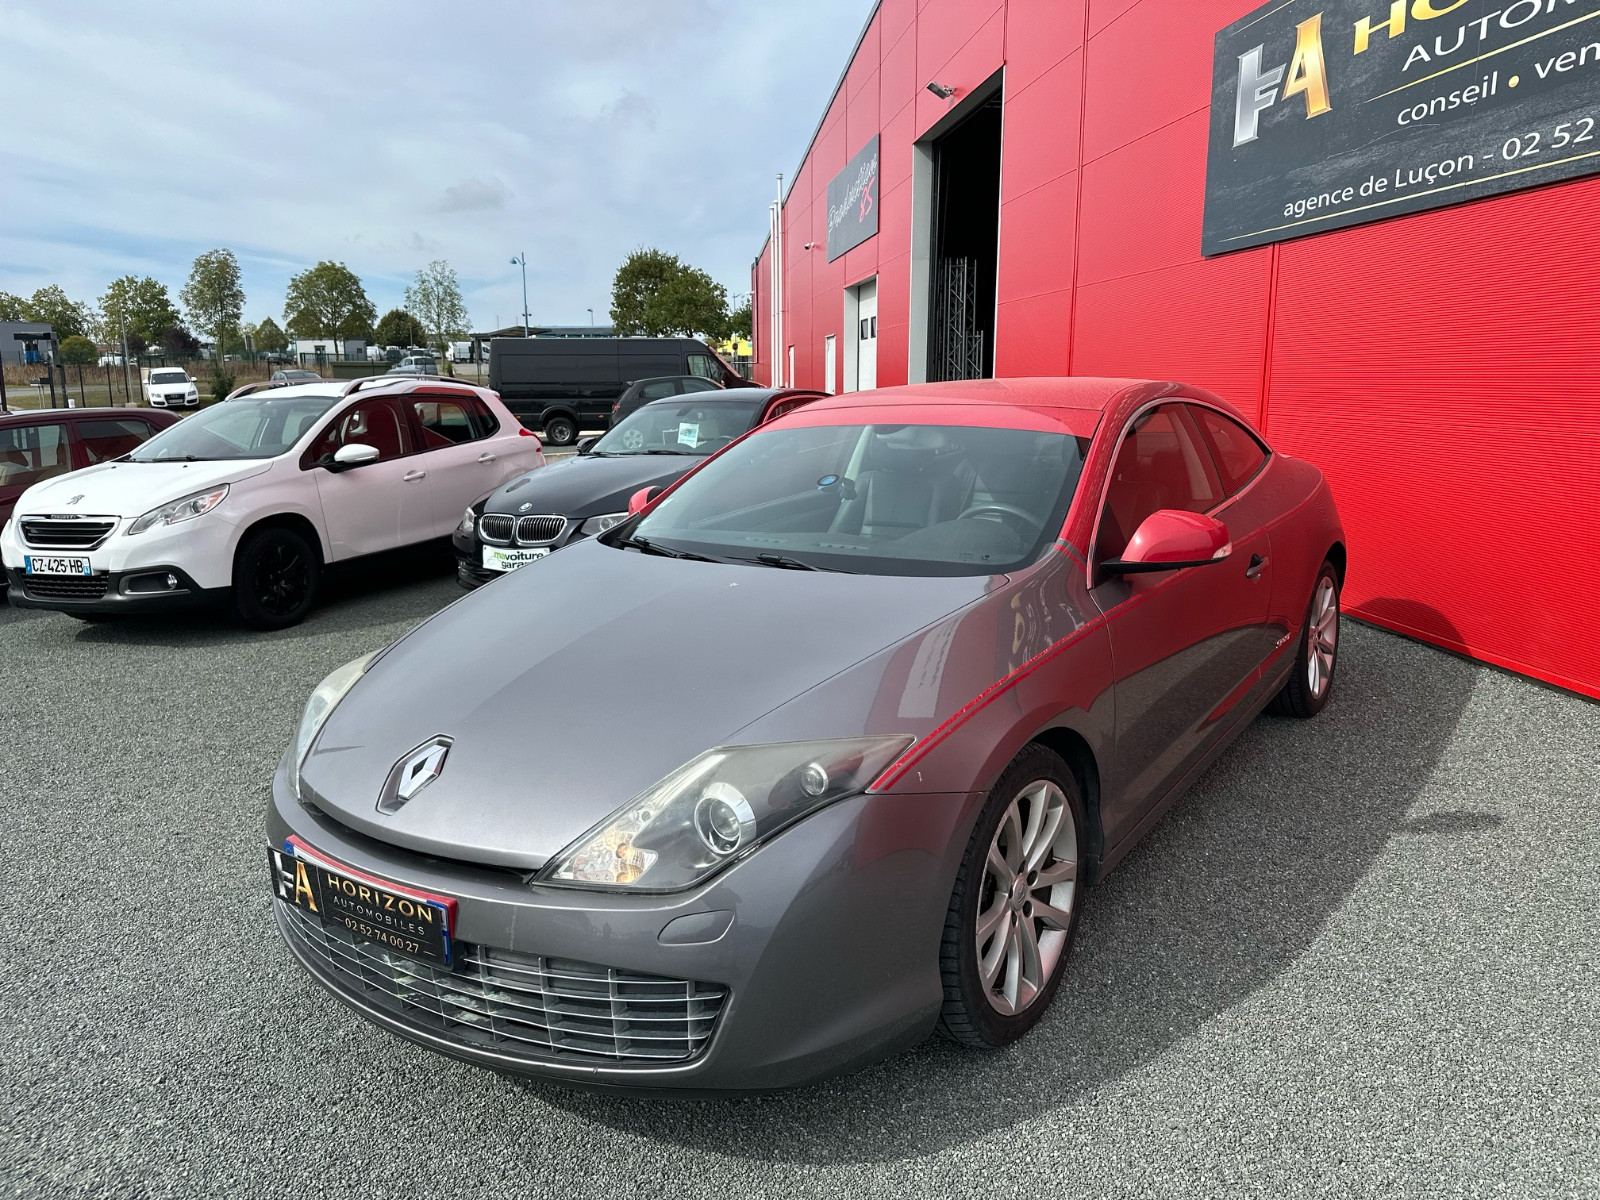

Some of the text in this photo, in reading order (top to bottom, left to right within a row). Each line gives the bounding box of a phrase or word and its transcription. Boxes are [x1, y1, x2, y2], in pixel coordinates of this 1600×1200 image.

[1397, 42, 1600, 126] conseil ven
[1283, 183, 1354, 219] agence
[1359, 174, 1388, 198] de
[1394, 153, 1474, 189] Luçon
[1501, 131, 1541, 161] 02
[1551, 117, 1595, 149] 52
[501, 560, 530, 570] gara
[327, 873, 433, 924] HORIZON
[333, 895, 425, 936] AUTOMOBILES
[345, 917, 419, 954] 02 52 74 00 27
